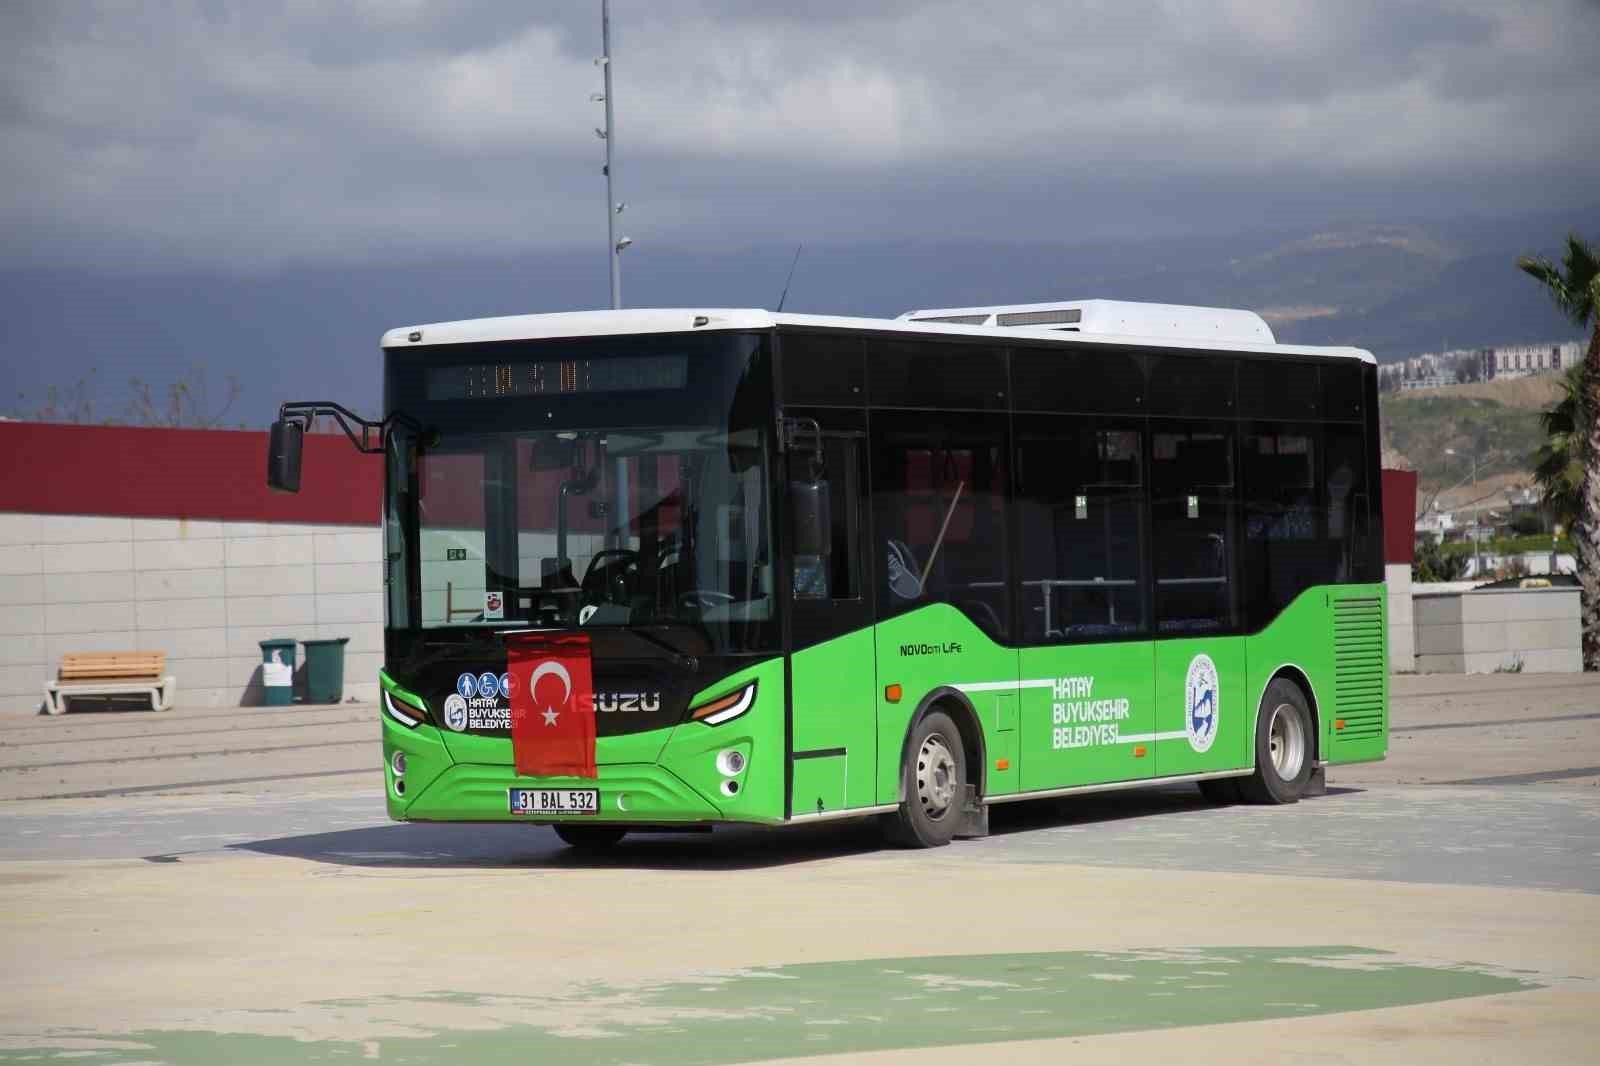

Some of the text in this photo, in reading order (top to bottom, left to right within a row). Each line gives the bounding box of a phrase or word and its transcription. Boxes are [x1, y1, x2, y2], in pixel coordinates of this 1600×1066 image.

[1052, 675, 1094, 700] HATAY
[468, 698, 498, 708] HATAY
[520, 792, 593, 809] 31 BAL 532
